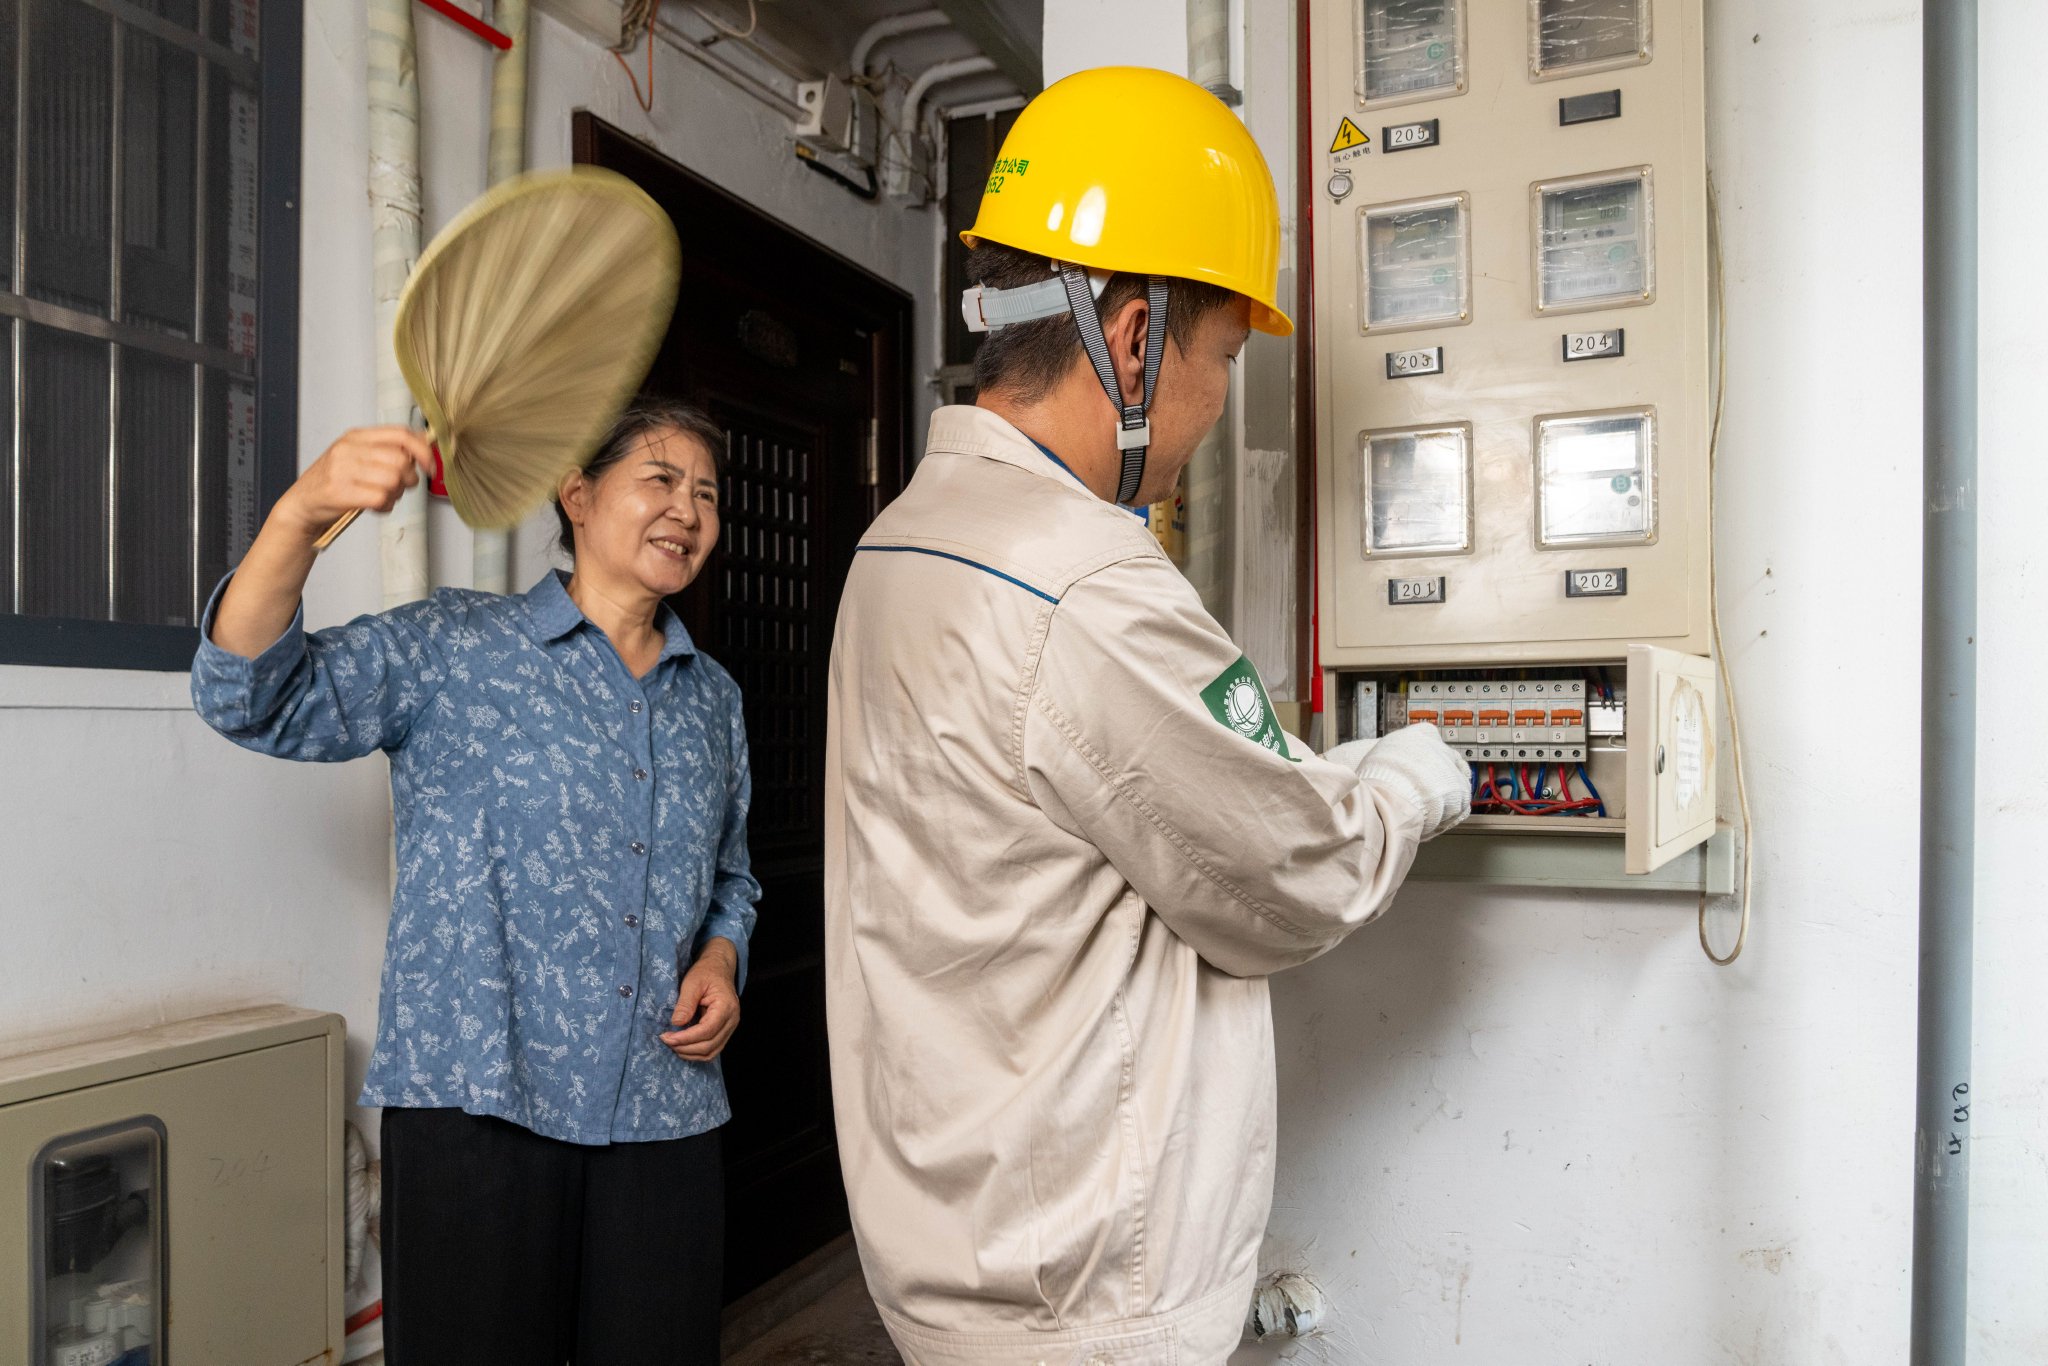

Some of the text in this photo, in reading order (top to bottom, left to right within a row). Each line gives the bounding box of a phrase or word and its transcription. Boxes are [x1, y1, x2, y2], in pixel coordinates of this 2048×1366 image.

[1395, 127, 1425, 143] 205
[1333, 147, 1371, 163] 当心触电
[1575, 334, 1608, 351] 204
[1399, 354, 1430, 369] 203
[1402, 581, 1434, 597] 201
[1580, 573, 1613, 589] 202
[1448, 729, 1454, 737] 2
